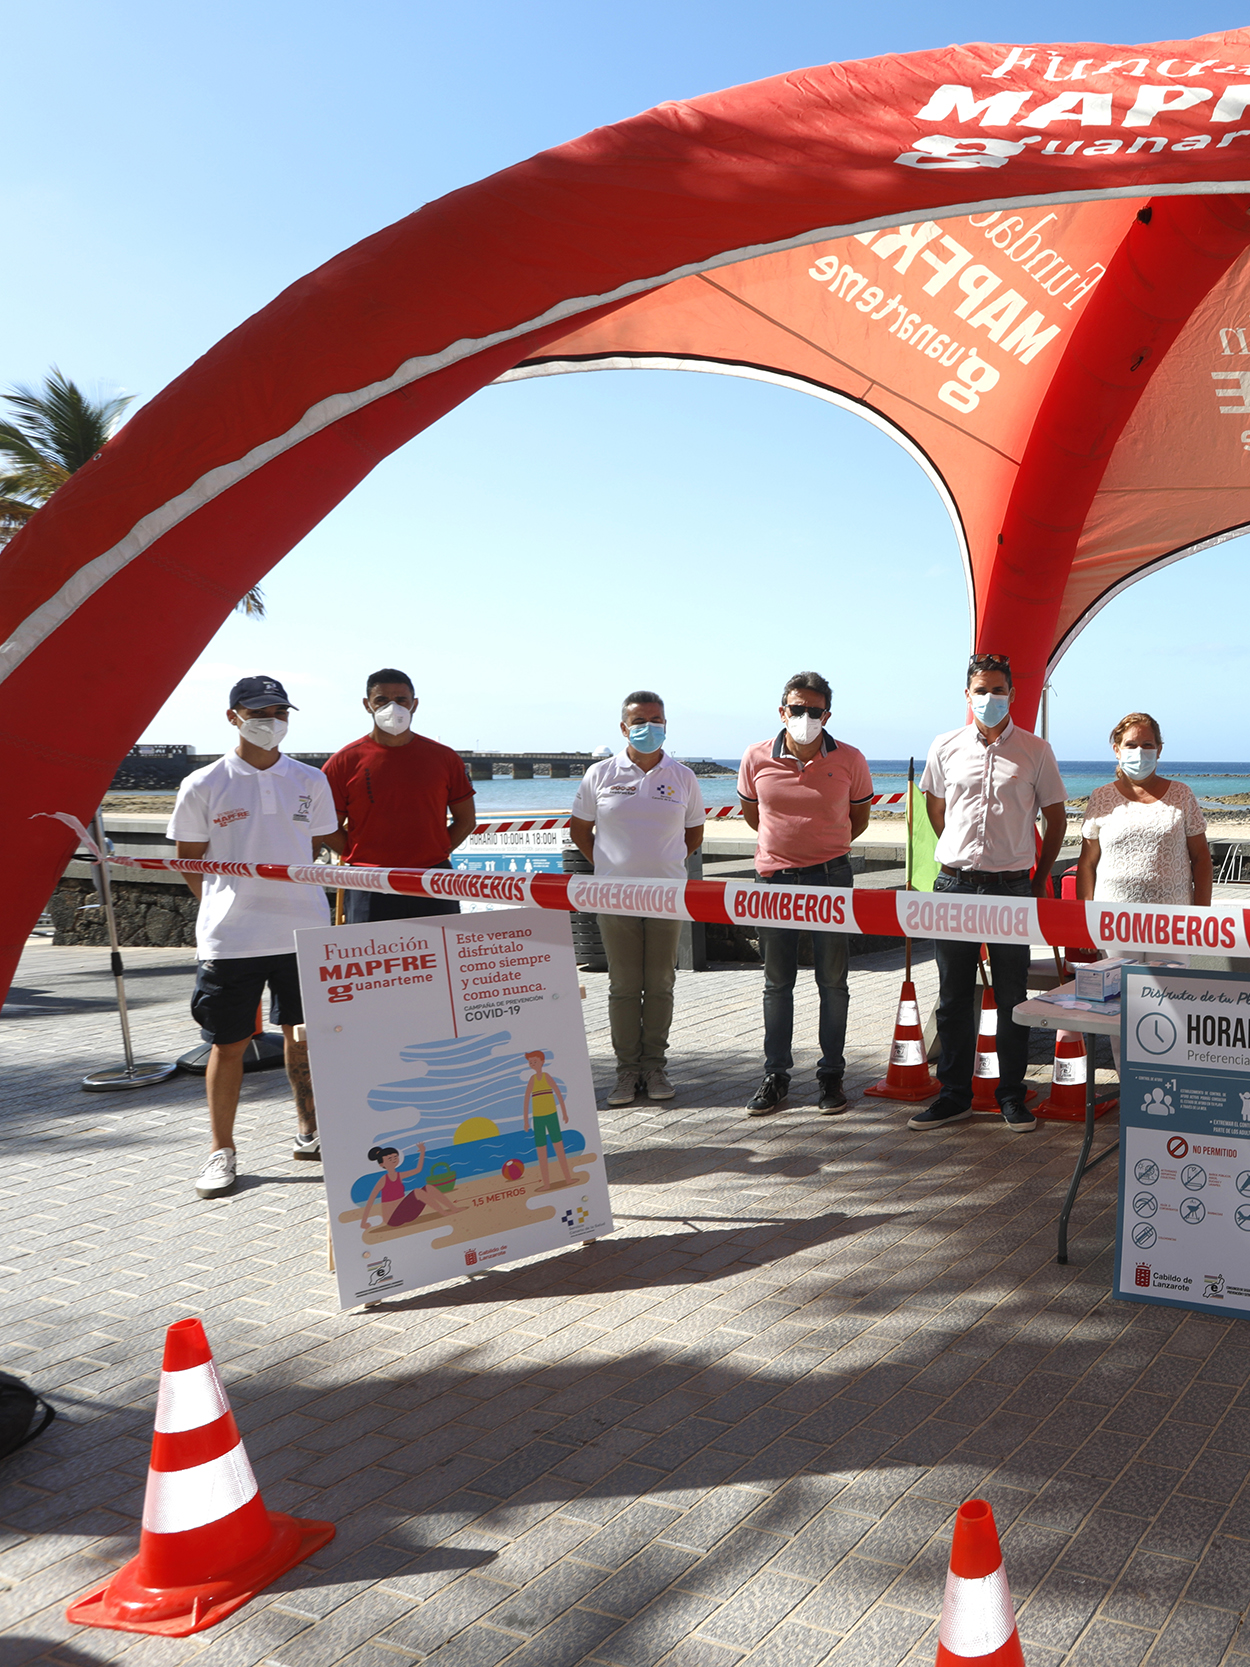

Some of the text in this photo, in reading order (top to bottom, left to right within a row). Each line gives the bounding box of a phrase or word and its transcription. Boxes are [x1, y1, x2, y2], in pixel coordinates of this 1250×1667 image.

[430, 873, 526, 901] BOMBEROS
[734, 890, 845, 925] BOMBEROS
[456, 929, 532, 945] Este verano
[1100, 911, 1236, 949] BOMBEROS
[323, 936, 429, 961] Fundación
[458, 942, 523, 958] disfrútalo
[319, 953, 437, 982] MAPFRE
[460, 954, 551, 972] como siempre
[327, 973, 433, 1003] guanarteme
[461, 972, 521, 990] y cuídate
[463, 982, 546, 1001] como nunca.
[1140, 986, 1197, 1006] Disfruta
[1200, 987, 1216, 1002] de
[1218, 990, 1234, 1003] tu
[464, 1002, 495, 1011] CAMPAÑA
[506, 995, 543, 1005] PREVENCIÓN
[465, 1005, 520, 1022] COVID-19
[1187, 1050, 1250, 1066] Preferencia
[1165, 1079, 1176, 1091] +1
[1193, 1145, 1237, 1158] NO PERMITIDO
[472, 1187, 526, 1207] 1,5 METROS
[1153, 1272, 1193, 1284] Cabildo de
[1153, 1281, 1190, 1292] Lanzarote
